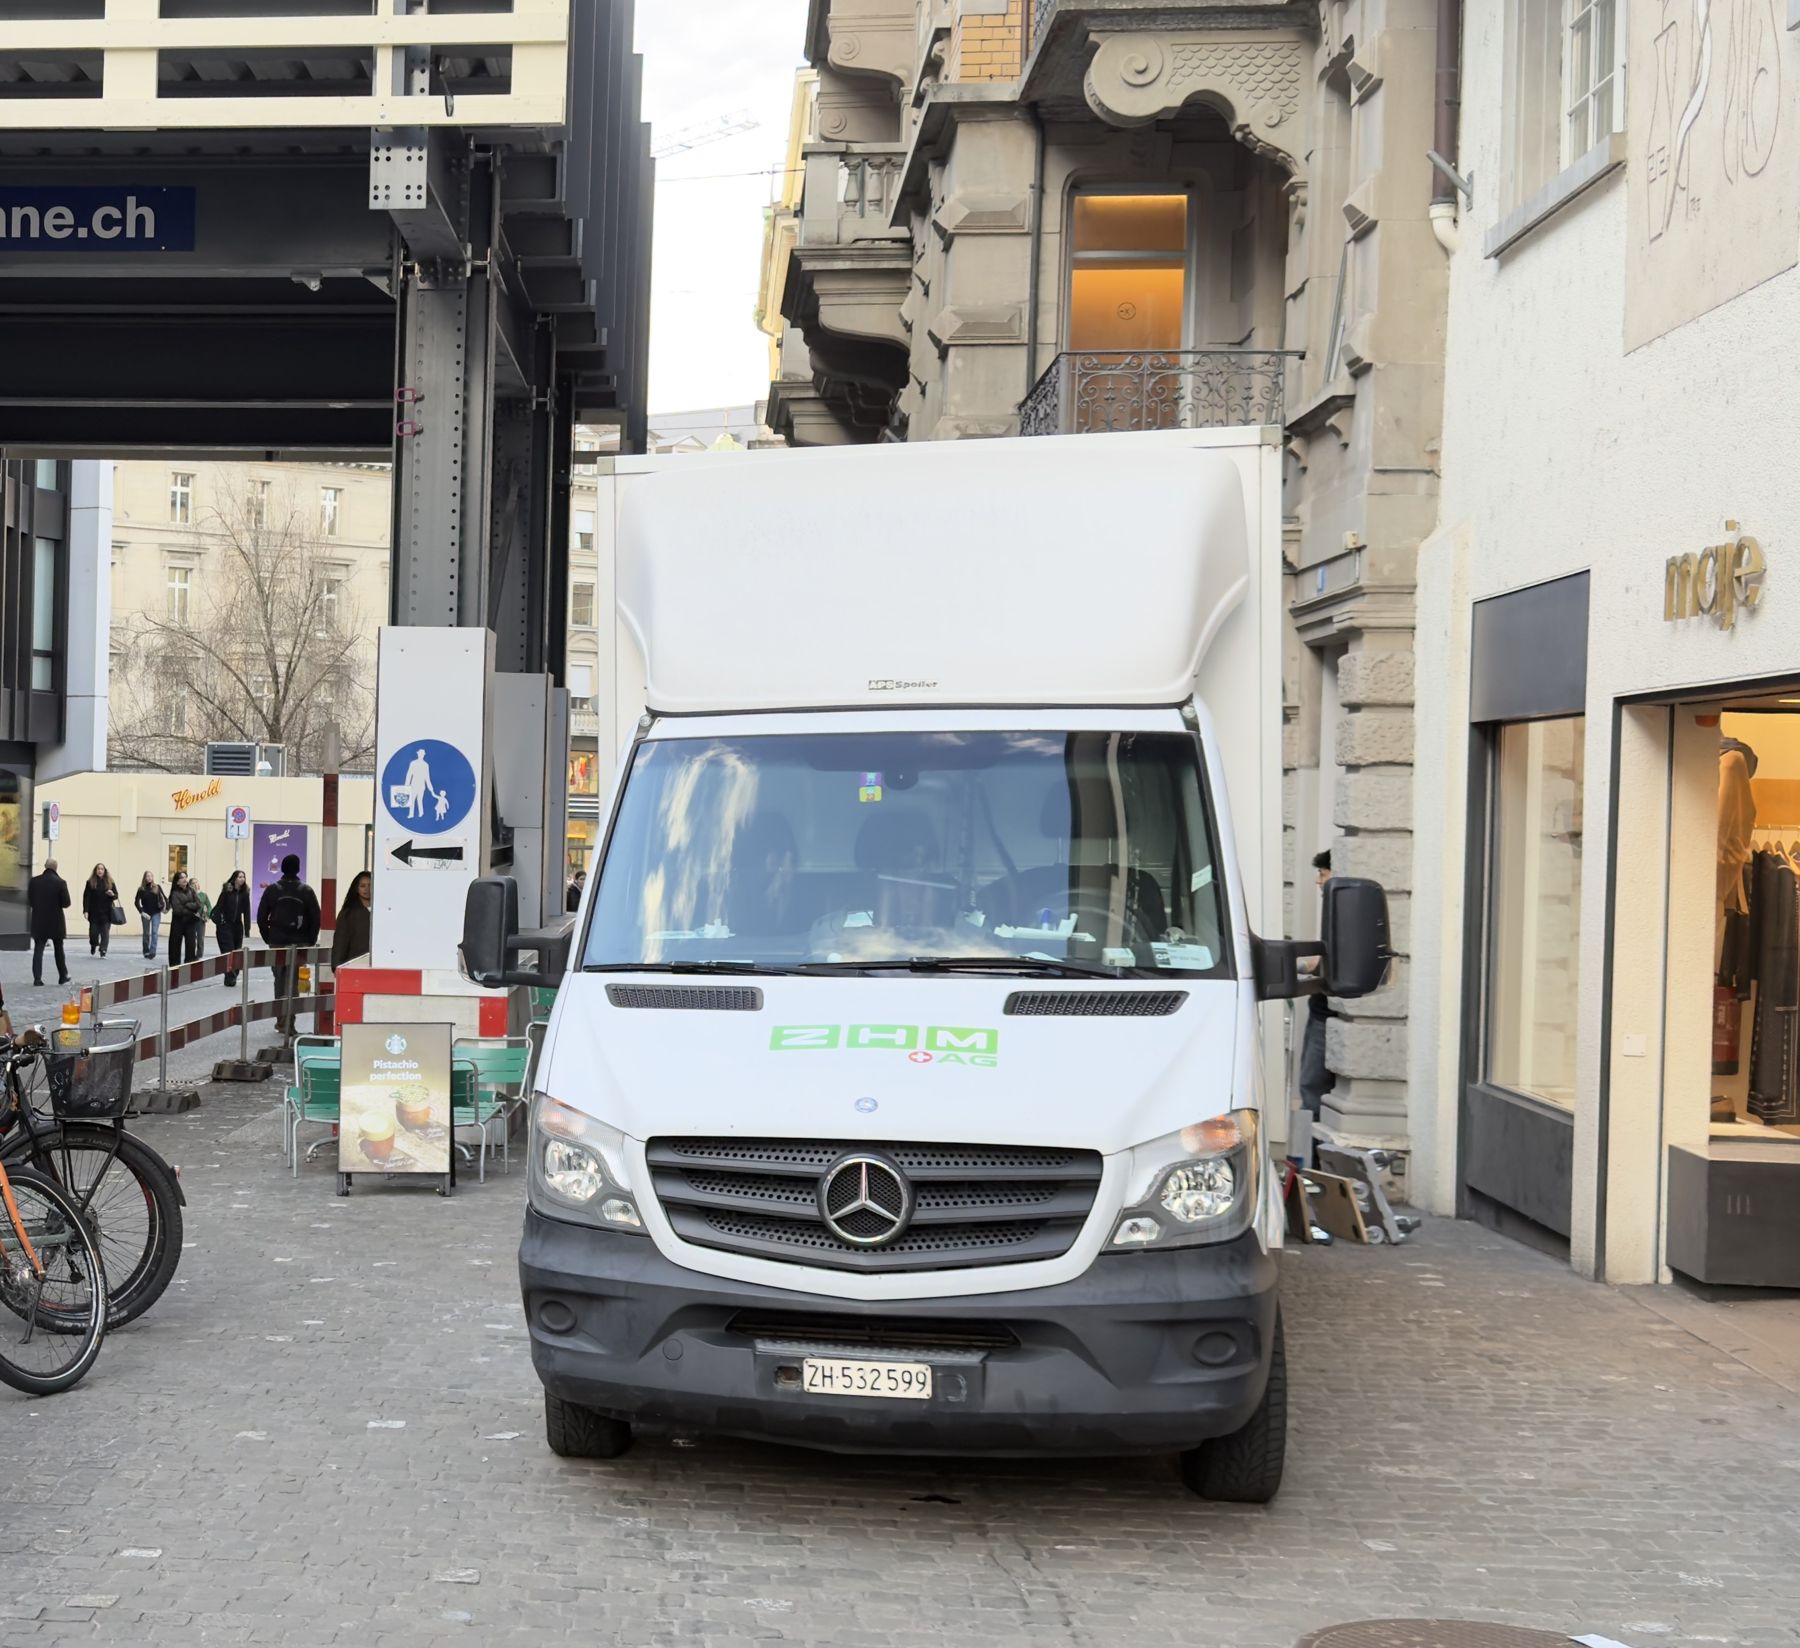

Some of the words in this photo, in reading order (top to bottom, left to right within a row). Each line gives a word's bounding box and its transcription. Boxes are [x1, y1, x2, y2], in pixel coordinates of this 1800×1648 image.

[0, 196, 155, 239] ne.ch
[1664, 519, 1767, 632] maje
[895, 681, 938, 689] Spoiler
[777, 1026, 992, 1051] ZHM
[373, 1060, 419, 1070] Pistachio
[936, 1053, 998, 1068] AG
[369, 1072, 422, 1082] perfection
